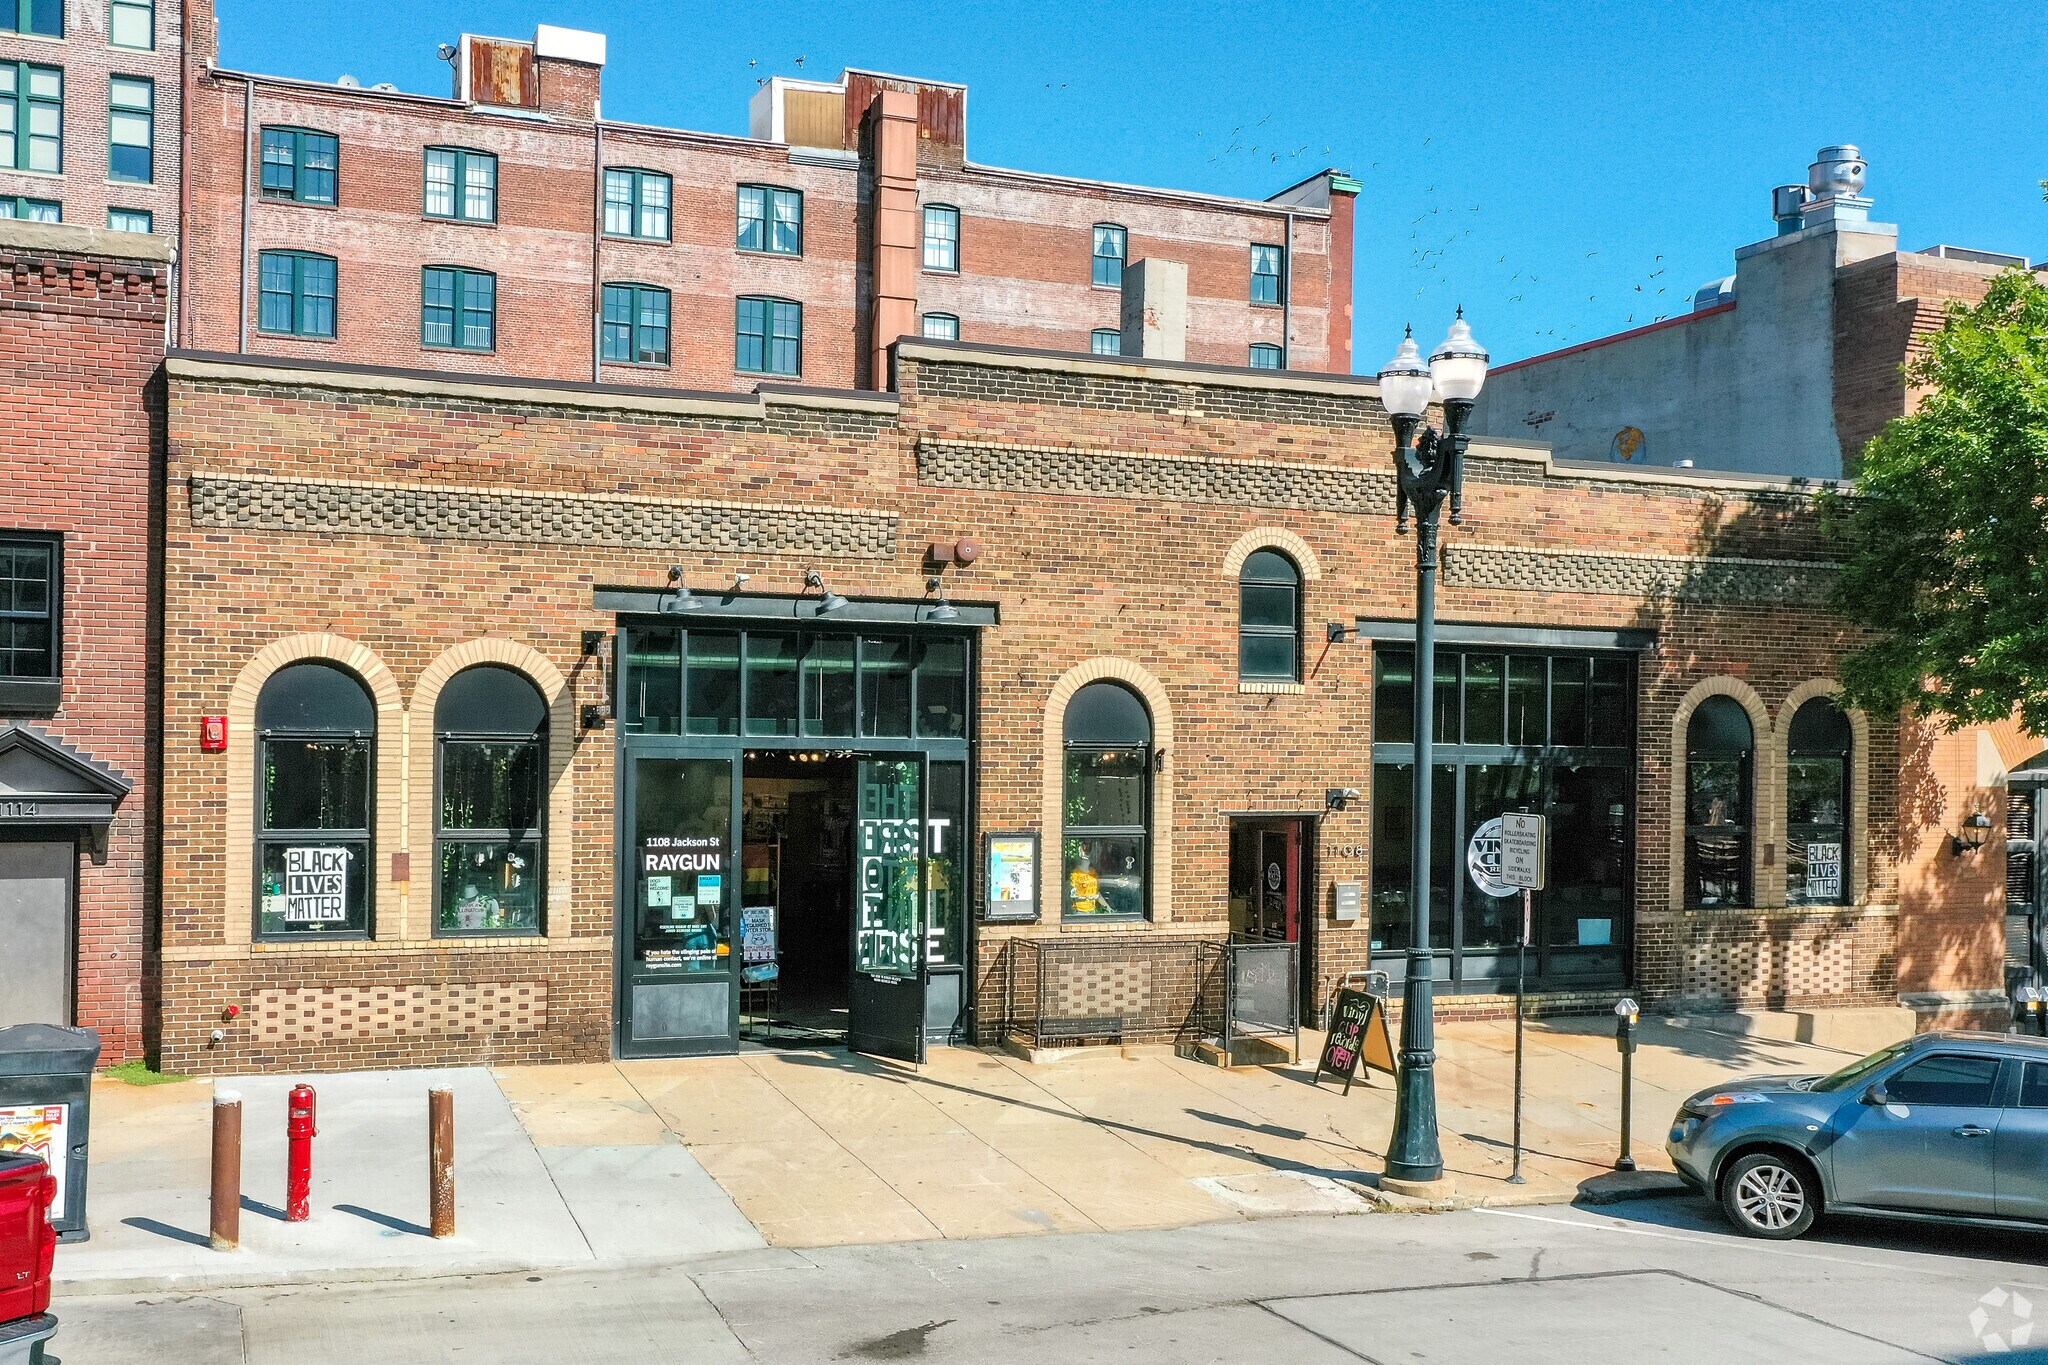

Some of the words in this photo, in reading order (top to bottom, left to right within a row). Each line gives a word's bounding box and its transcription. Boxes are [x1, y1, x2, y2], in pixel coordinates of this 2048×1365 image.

[1515, 820, 1525, 829] NO
[1504, 830, 1536, 838] ROLLERSKATING
[646, 837, 670, 847] 1108
[671, 837, 708, 847] Jackson
[709, 836, 720, 847] St
[1504, 838, 1536, 847] SKATEBOARDING
[1509, 847, 1530, 855] BICYCLING
[1809, 845, 1839, 861] BLACK
[288, 850, 344, 872] BLACK
[646, 854, 720, 871] RAYGUN
[1515, 856, 1524, 864] ON
[1507, 865, 1531, 873] SIDEWALKS
[1810, 863, 1838, 877] LIVES
[291, 875, 342, 894] LIVES
[1807, 879, 1838, 896] MATTER
[287, 896, 342, 920] MATTER
[16, 1271, 31, 1280] LT
